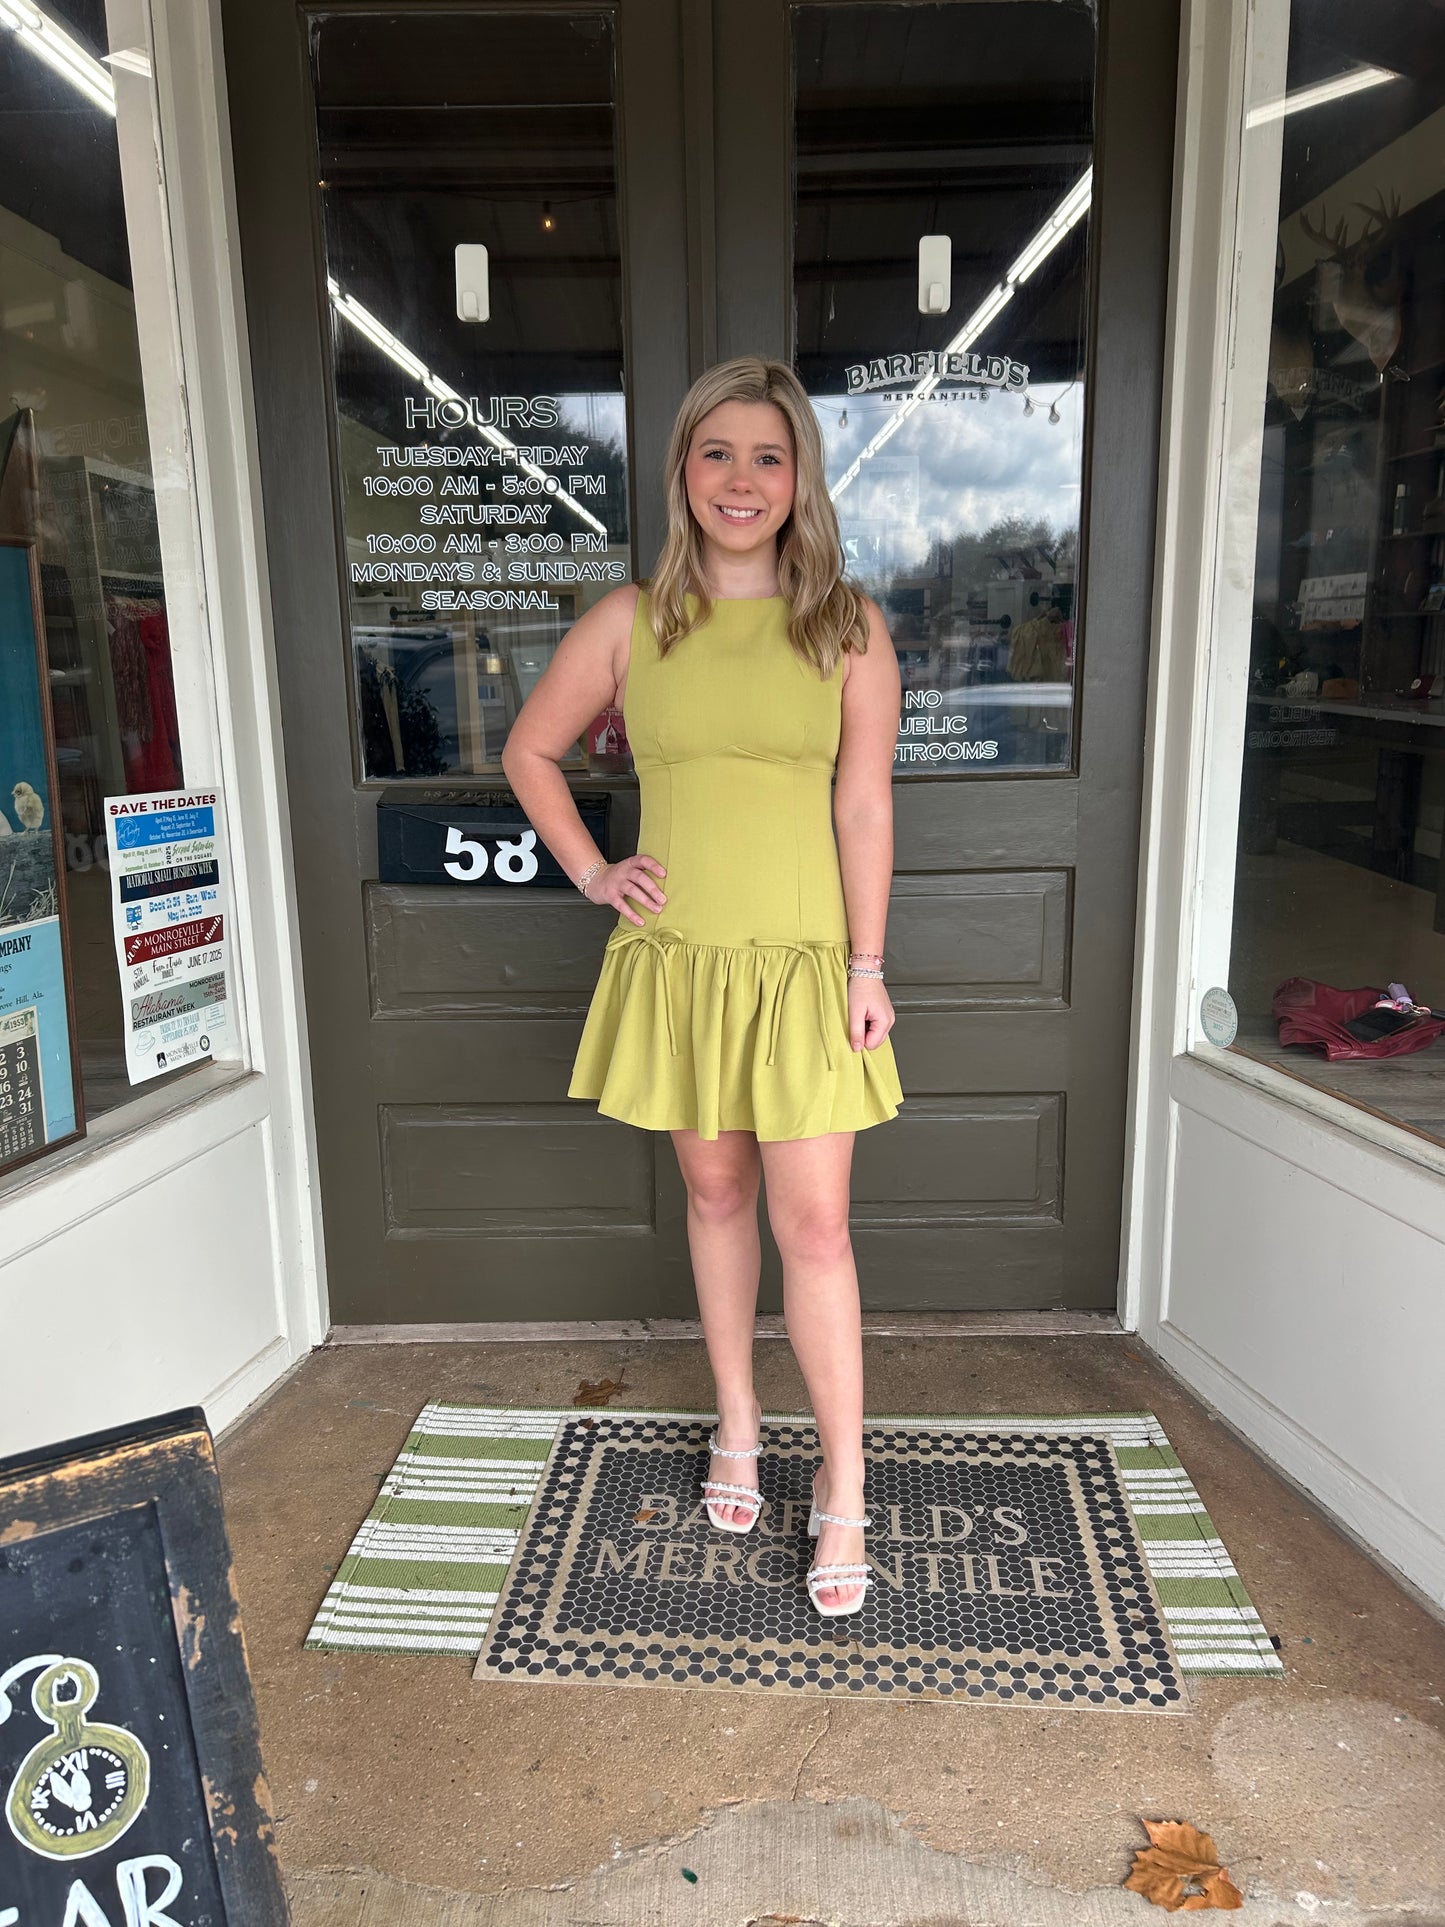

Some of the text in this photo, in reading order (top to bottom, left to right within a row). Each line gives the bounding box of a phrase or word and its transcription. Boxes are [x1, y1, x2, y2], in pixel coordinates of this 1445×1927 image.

[845, 350, 1031, 396] BARFIELD'S
[883, 392, 987, 401] MERCANTILE
[405, 396, 558, 429] HOURS
[377, 446, 588, 466] TUESDAY-FRIDAY
[364, 476, 433, 496] 10:00
[440, 476, 479, 496] AM
[502, 476, 558, 496] 5:00
[569, 476, 606, 494] PM
[420, 504, 552, 525] SATURDAY
[366, 534, 436, 554] 10:00
[444, 534, 481, 553] AM
[505, 534, 563, 553] 3:00
[571, 534, 608, 552] PM
[351, 562, 626, 582] MONDAYS & SUNDAYS
[422, 591, 558, 610] SEASONAL
[905, 690, 942, 708] NO
[898, 716, 968, 736] UBLIC
[110, 794, 216, 816] SAVE THE DATES
[444, 827, 538, 883] 58
[126, 872, 154, 888] NATIONAL
[154, 868, 172, 884] SMALL
[172, 864, 198, 880] BUSINESS
[198, 861, 213, 875] WEEK
[144, 922, 204, 947] MONROEVILLE
[204, 916, 222, 942] Month
[127, 936, 142, 963] JUNE
[151, 934, 200, 956] MAIN STREET
[188, 953, 202, 968] JUNE
[210, 948, 222, 962] 2025
[190, 973, 224, 988] MONROEVILLE
[132, 992, 185, 1020] Alabama
[133, 1009, 175, 1030] RESTAURANT
[176, 1002, 195, 1014] WEEK
[10, 1017, 24, 1029] 1953
[16, 1046, 25, 1059] 3
[16, 1060, 28, 1074] 10
[0, 1086, 32, 1109] 23 24
[20, 1101, 32, 1114] 31
[590, 1539, 1074, 1597] MERCNTILE
